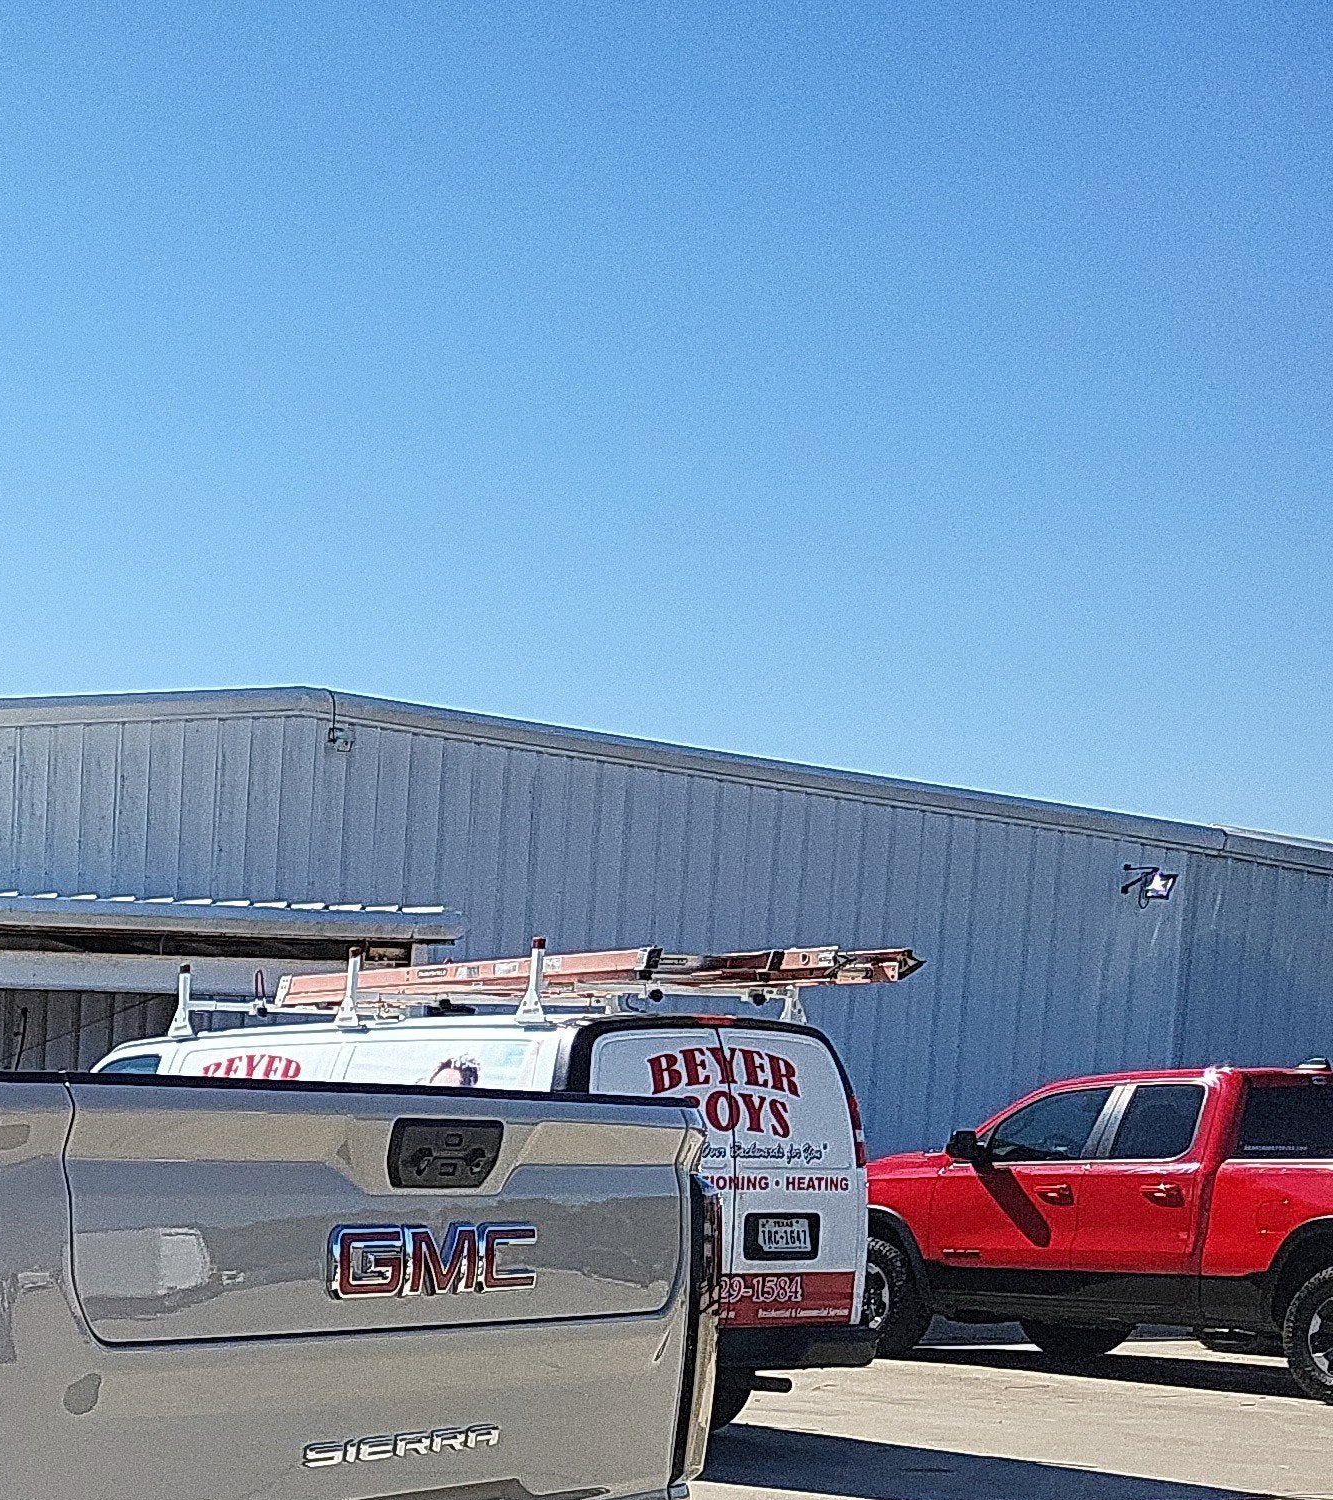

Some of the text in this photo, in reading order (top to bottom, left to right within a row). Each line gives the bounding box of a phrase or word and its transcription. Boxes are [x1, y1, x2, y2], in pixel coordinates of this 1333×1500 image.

[647, 1047, 801, 1097] BEYER
[785, 1176, 849, 1192] HEATING
[329, 1221, 537, 1300] GMC
[302, 1423, 500, 1468] SIERRA
